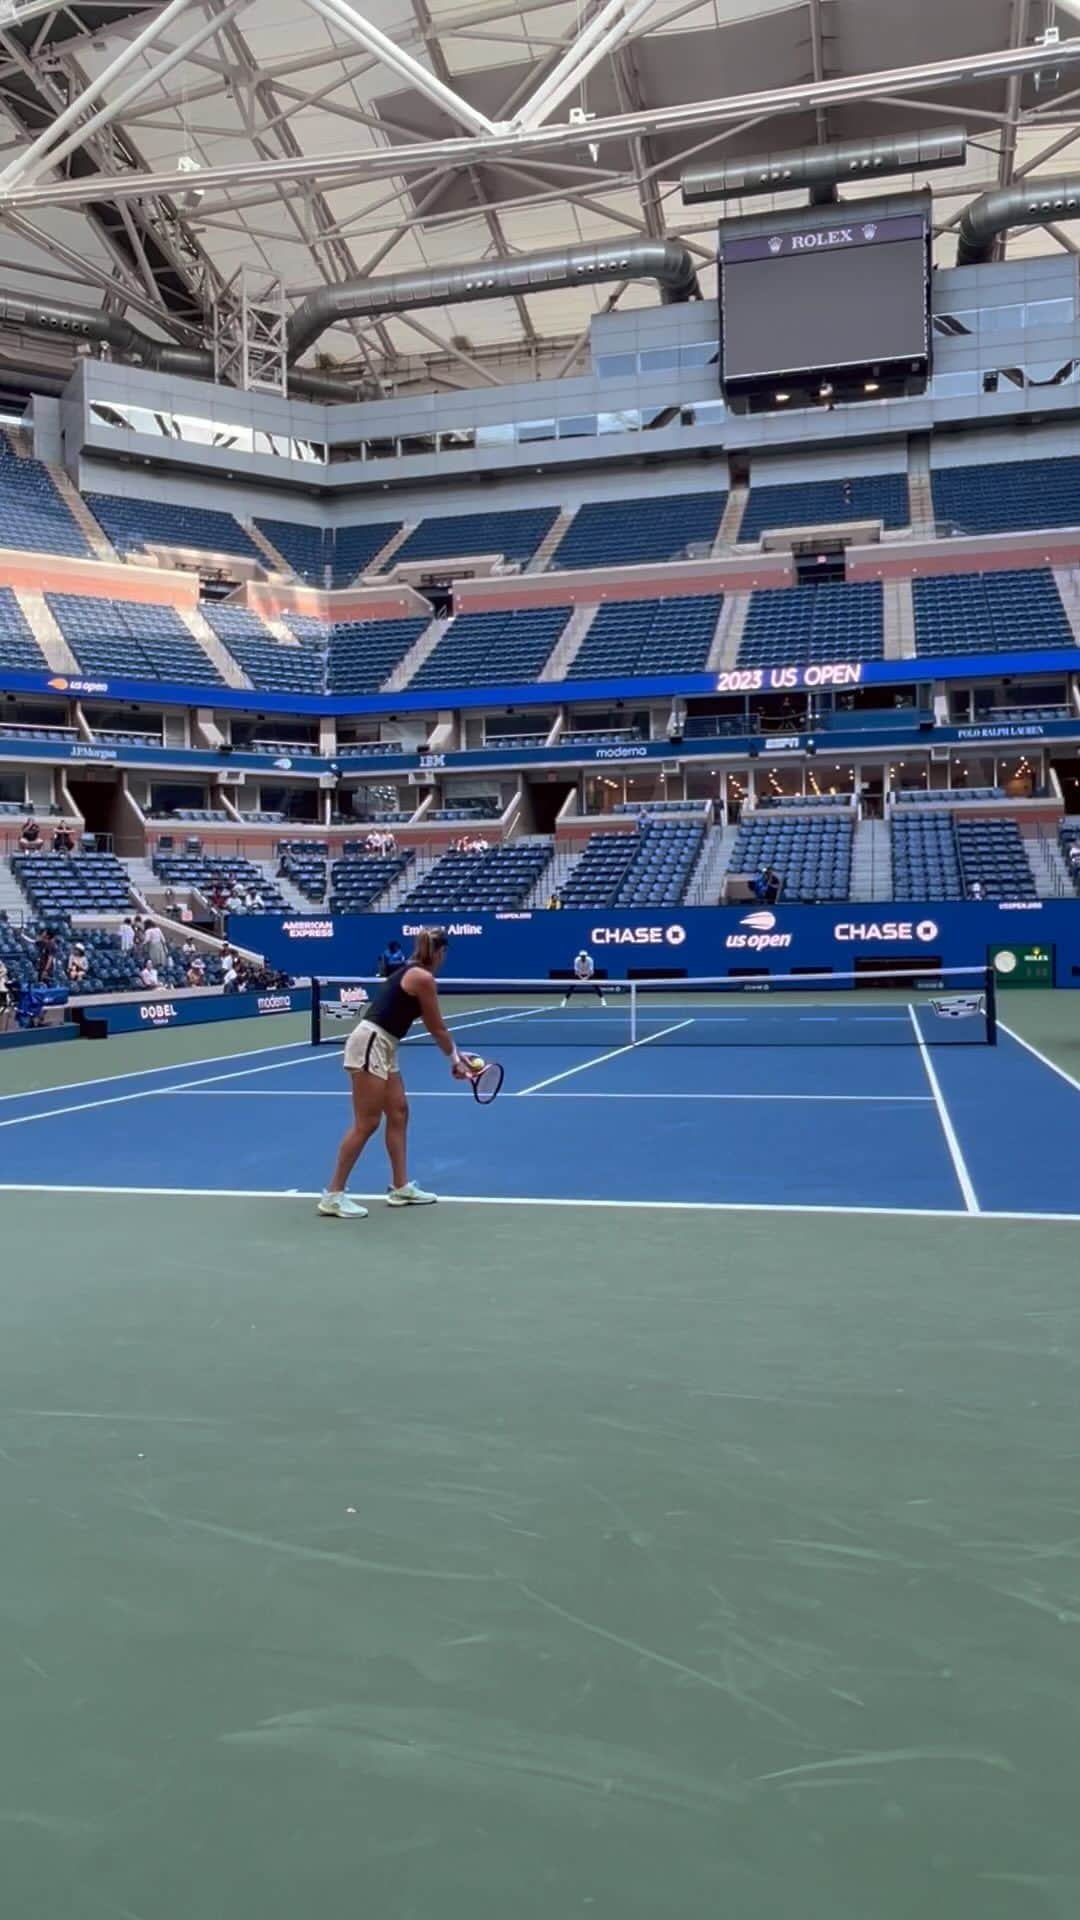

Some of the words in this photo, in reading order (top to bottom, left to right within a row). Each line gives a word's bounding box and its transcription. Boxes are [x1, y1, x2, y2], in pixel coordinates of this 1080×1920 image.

[792, 230, 853, 249] ROLEX
[717, 670, 763, 691] 2023
[770, 668, 798, 688] US
[803, 664, 861, 686] OPEN
[83, 683, 108, 692] open
[958, 729, 980, 739] POLO
[982, 727, 1009, 737] RALPH
[765, 738, 799, 749] ESPN
[596, 747, 647, 758] moderna
[419, 754, 446, 767] IBM
[282, 921, 333, 930] AMERICAN
[448, 923, 483, 935] Airline
[289, 929, 334, 937] EXPRESS
[591, 927, 663, 944] CHASE
[834, 923, 913, 941] CHASE
[726, 934, 747, 948] us
[747, 933, 793, 951] open
[140, 1004, 177, 1019] DOBEL
